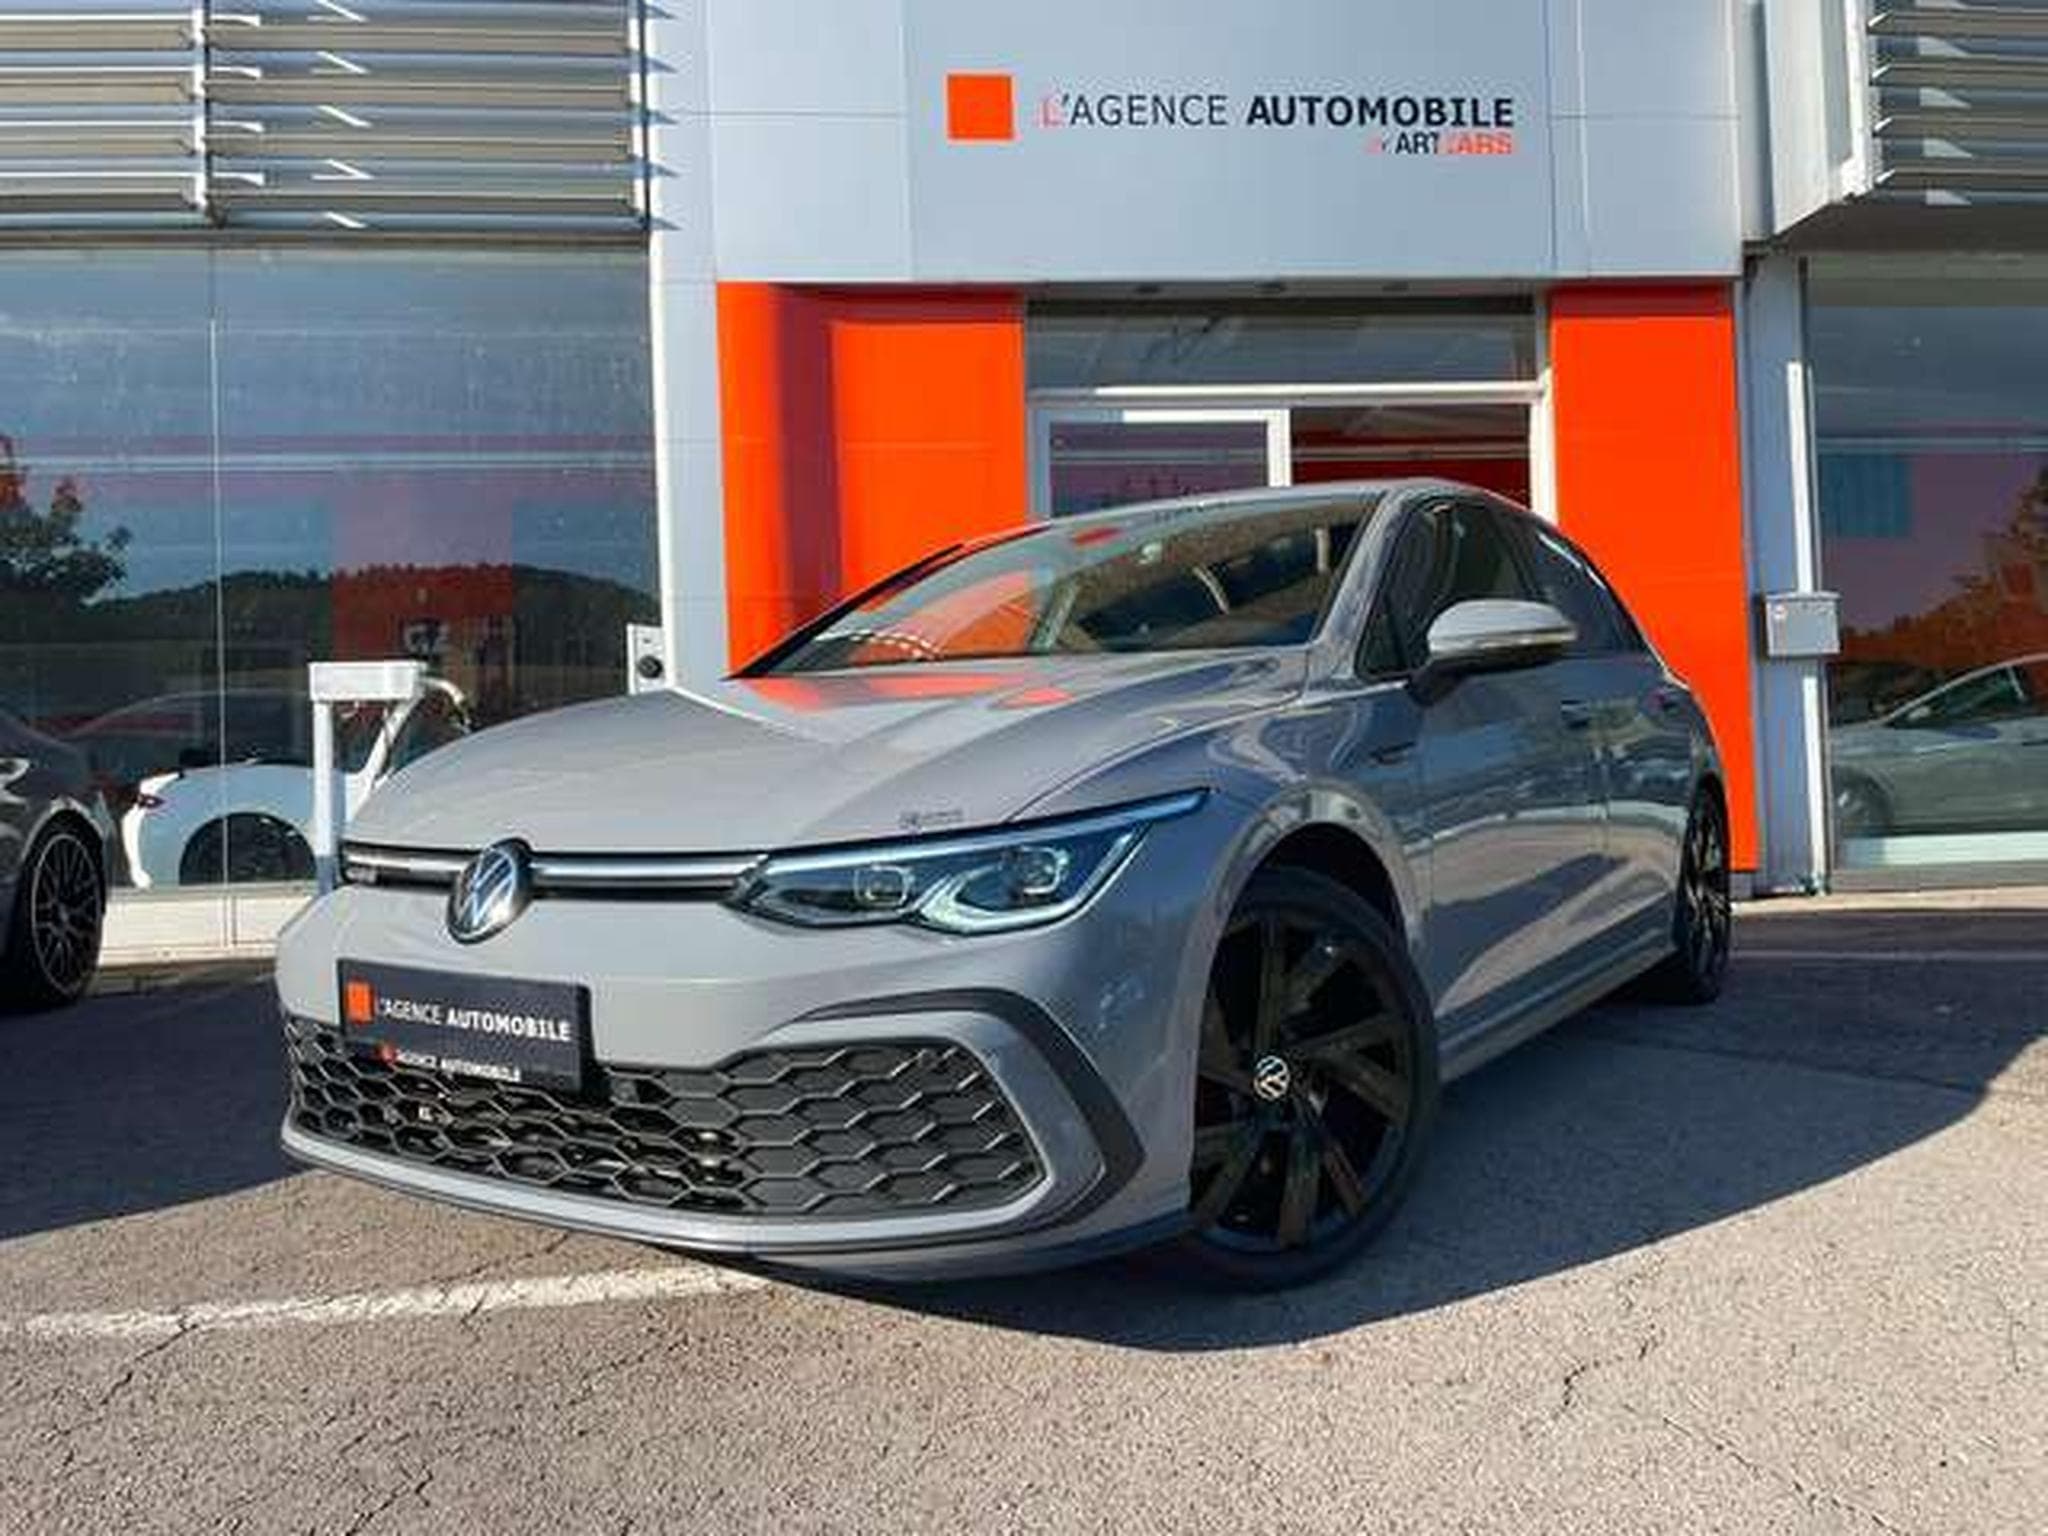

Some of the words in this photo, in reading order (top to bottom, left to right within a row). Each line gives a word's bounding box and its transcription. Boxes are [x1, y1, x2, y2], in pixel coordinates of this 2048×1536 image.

[1042, 94, 1229, 126] L'AGENCE
[1246, 95, 1515, 127] AUTOMOBILE
[1395, 131, 1513, 155] ARTARS
[376, 997, 441, 1026] 'AGENCE
[446, 1007, 572, 1042] AUTOMOBILE
